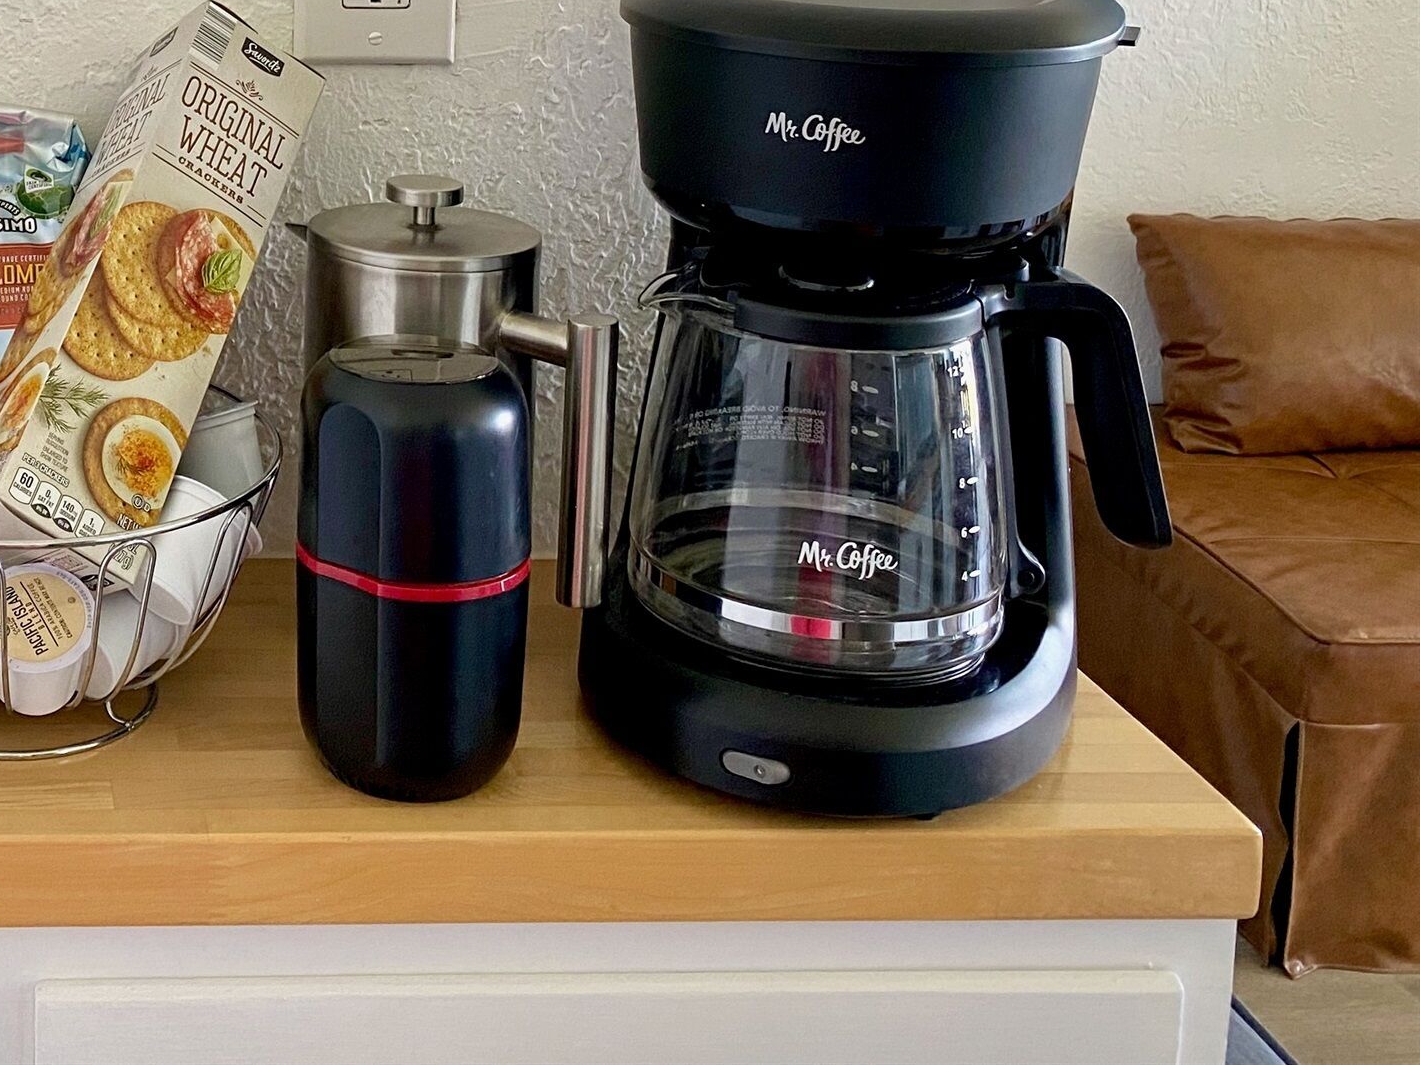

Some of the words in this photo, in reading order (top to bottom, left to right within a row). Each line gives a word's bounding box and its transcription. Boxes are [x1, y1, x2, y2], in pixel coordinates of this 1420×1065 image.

[181, 76, 286, 170] ORIGINAL
[765, 112, 799, 142] Mr.
[802, 114, 866, 152] Coffee
[180, 115, 268, 198] WHEAT
[178, 156, 244, 205] CRACKERS
[947, 365, 959, 377] 12
[952, 428, 963, 439] 10
[22, 452, 36, 466] PER
[39, 463, 70, 488] CRACKERS
[13, 482, 33, 497] CALORIES
[20, 472, 34, 489] 60
[959, 478, 966, 489] 8
[37, 495, 46, 503] SAT
[45, 498, 55, 507] FAT
[117, 513, 133, 531] NET
[961, 526, 968, 538] 6
[798, 541, 833, 572] Mr.
[836, 541, 898, 580] Coffee
[961, 571, 968, 582] 4
[27, 583, 40, 602] COFFEE
[5, 586, 29, 620] ISLAND
[25, 602, 45, 630] BLEND
[40, 603, 55, 627] ARABICA
[20, 618, 49, 656] PACIFIC
[52, 626, 63, 640] 100%
